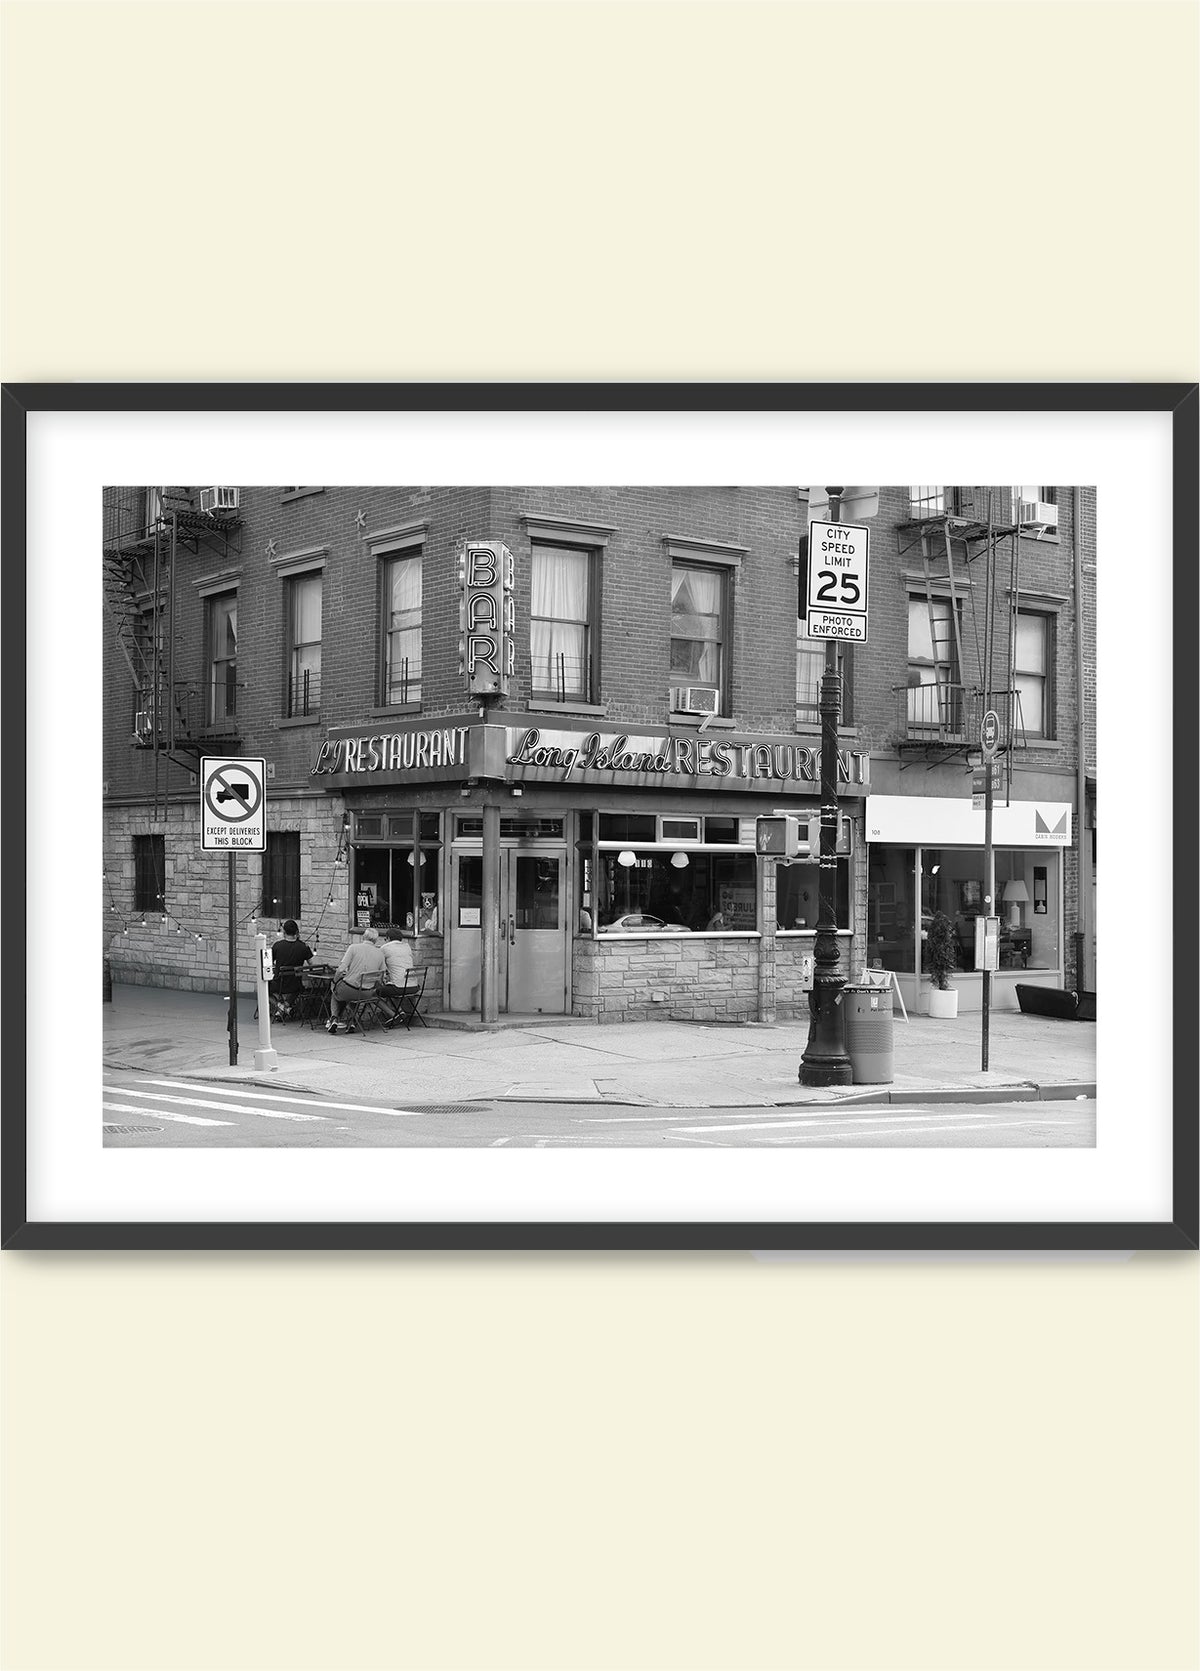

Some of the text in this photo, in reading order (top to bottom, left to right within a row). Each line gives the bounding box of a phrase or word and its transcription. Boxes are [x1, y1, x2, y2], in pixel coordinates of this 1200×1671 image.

[826, 528, 850, 540] CITY
[821, 541, 855, 555] SPEED
[824, 555, 852, 567] LIMIT
[816, 570, 860, 604] 25
[467, 548, 499, 674] BAR
[822, 615, 853, 626] PHOTO
[813, 624, 862, 637] ENFORCED
[344, 726, 469, 773] RESTAURANT
[510, 727, 579, 780] Long
[580, 732, 672, 771] Island
[206, 826, 261, 836] EXCEPT DELIVERIES
[214, 837, 253, 846] THIS BLOCK
